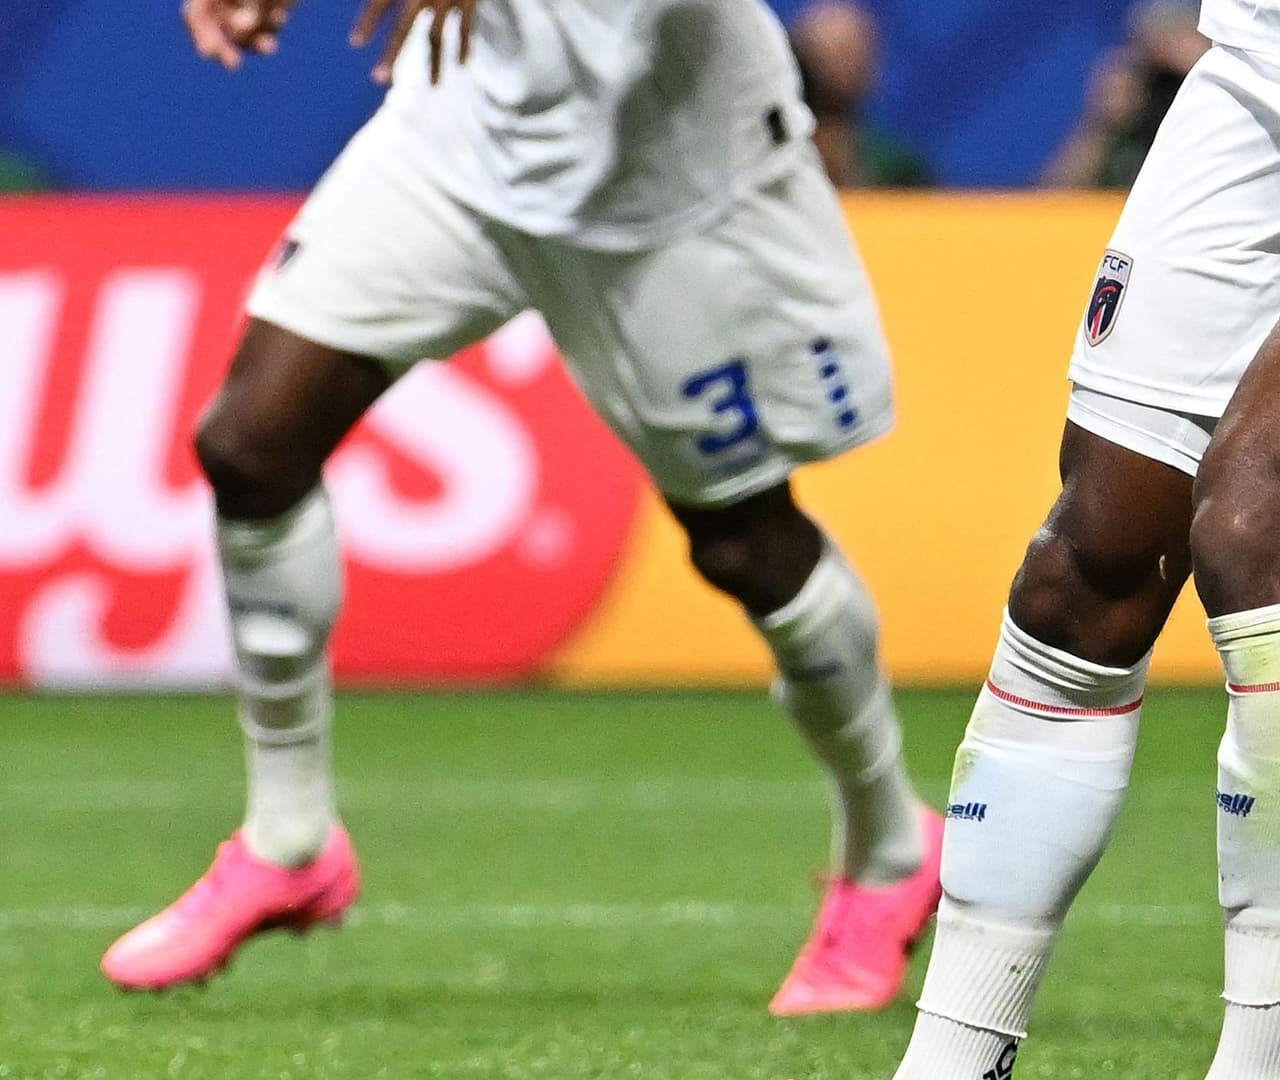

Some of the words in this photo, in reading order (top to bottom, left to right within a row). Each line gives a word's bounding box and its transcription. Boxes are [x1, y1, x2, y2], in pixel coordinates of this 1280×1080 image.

[1103, 255, 1129, 272] FCF
[682, 360, 758, 454] 3
[949, 803, 987, 819] elli
[1218, 793, 1256, 813] elli
